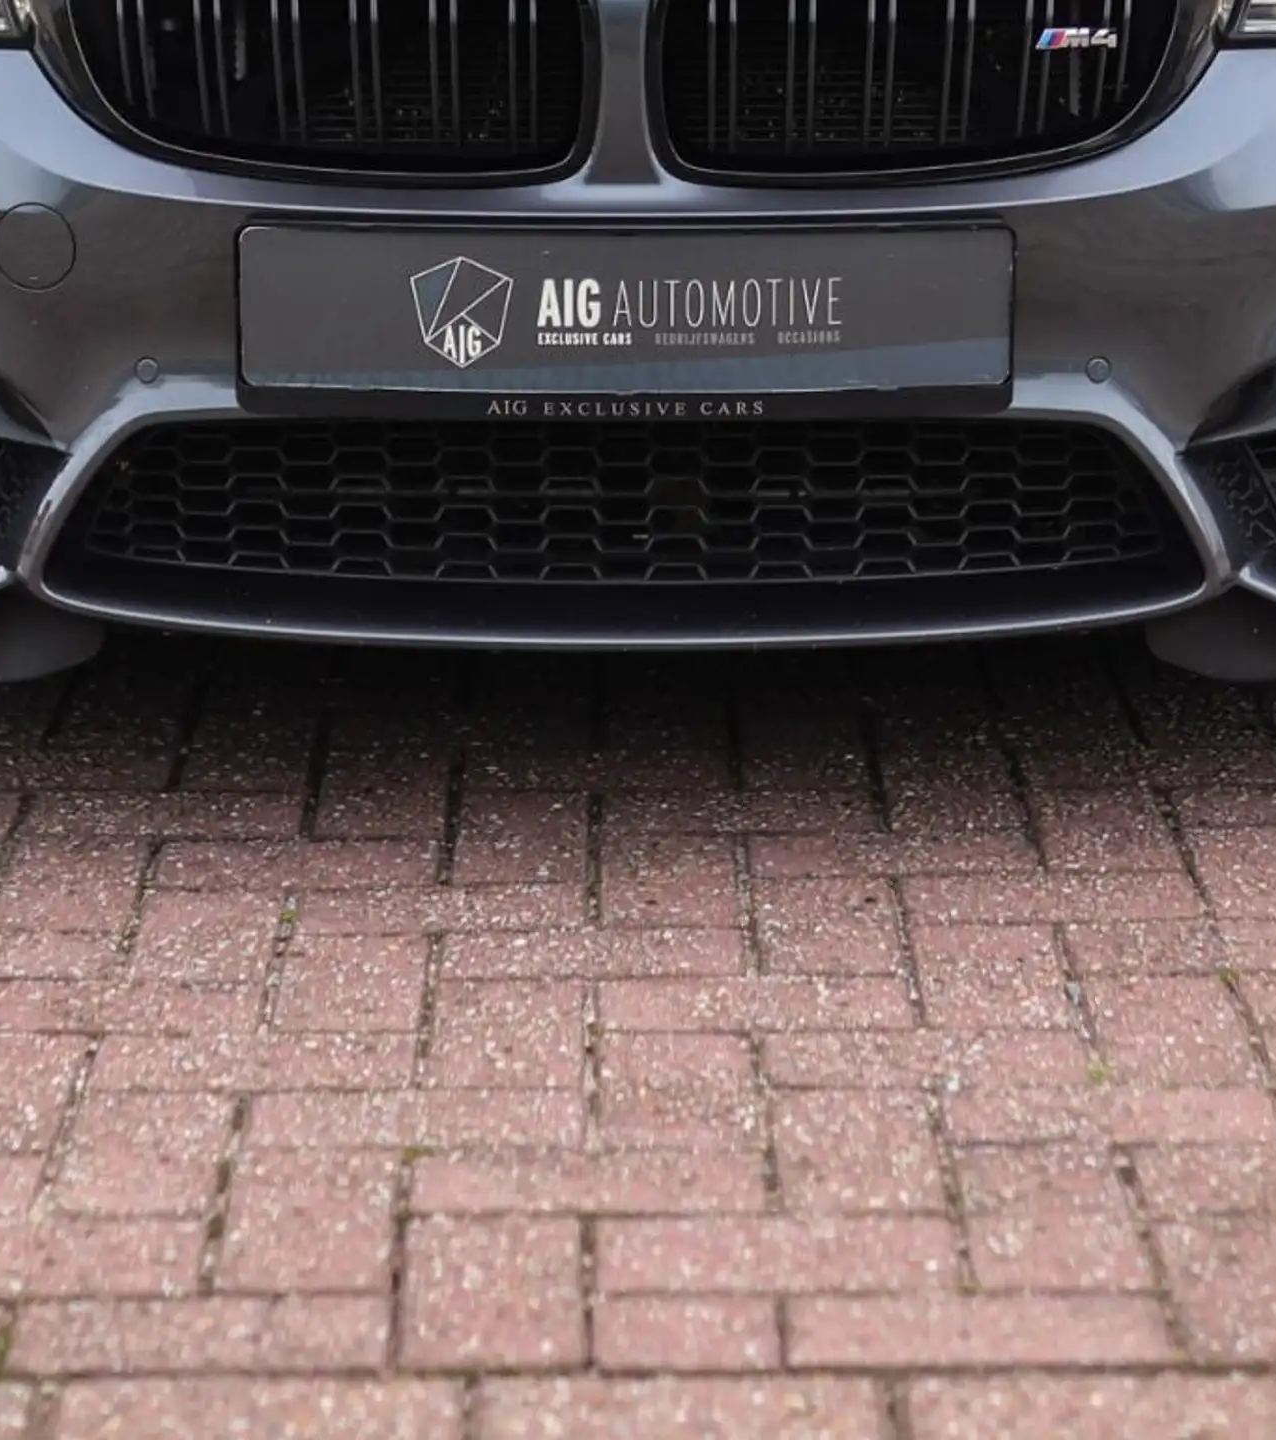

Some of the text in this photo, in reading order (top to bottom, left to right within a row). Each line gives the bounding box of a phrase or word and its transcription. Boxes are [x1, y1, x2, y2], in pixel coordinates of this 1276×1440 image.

[1057, 27, 1118, 49] M4
[537, 277, 843, 328] AIG AUTOMOTIVE
[443, 324, 483, 364] AIG
[537, 332, 598, 346] EXCLUSIVE
[602, 332, 632, 346] CARS
[487, 400, 763, 416] AIG EXCLUSIVE CARS
